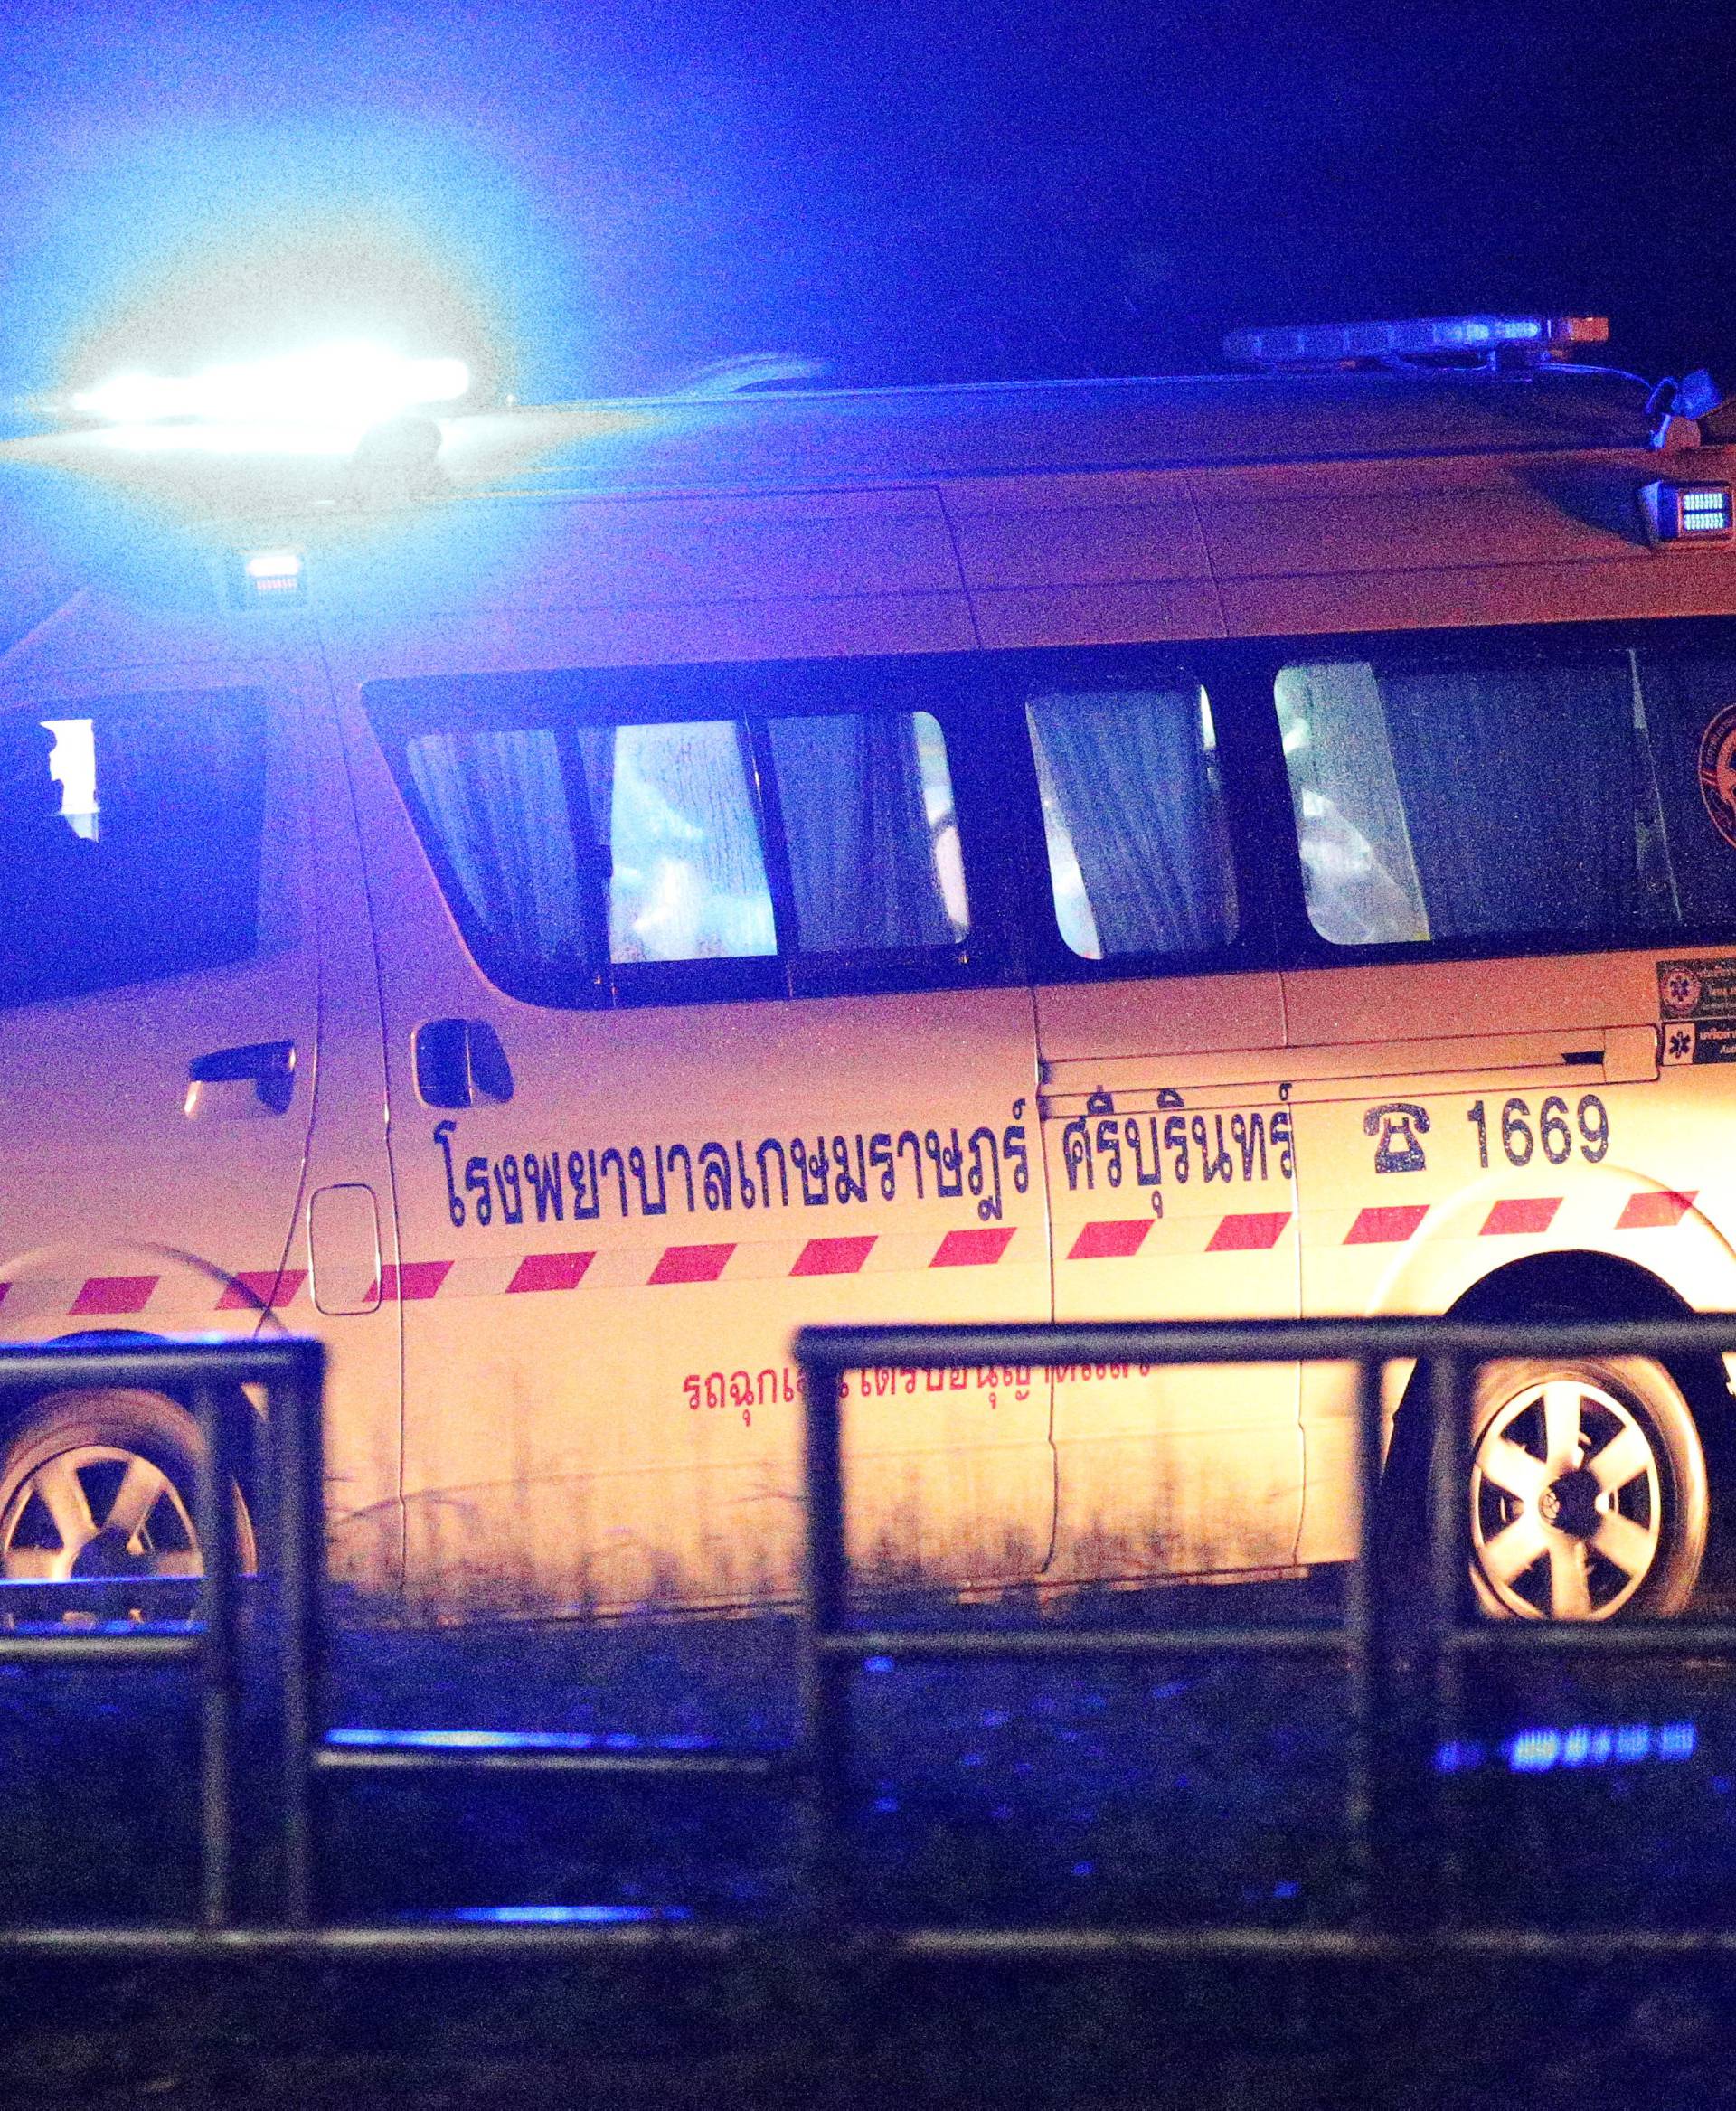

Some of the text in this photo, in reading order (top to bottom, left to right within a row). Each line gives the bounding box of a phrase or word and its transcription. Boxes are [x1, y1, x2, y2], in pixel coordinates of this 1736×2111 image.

[434, 1098, 1029, 1228] โรงพยาบาลเกษมราษฎร์
[1467, 1094, 1609, 1169] 1669
